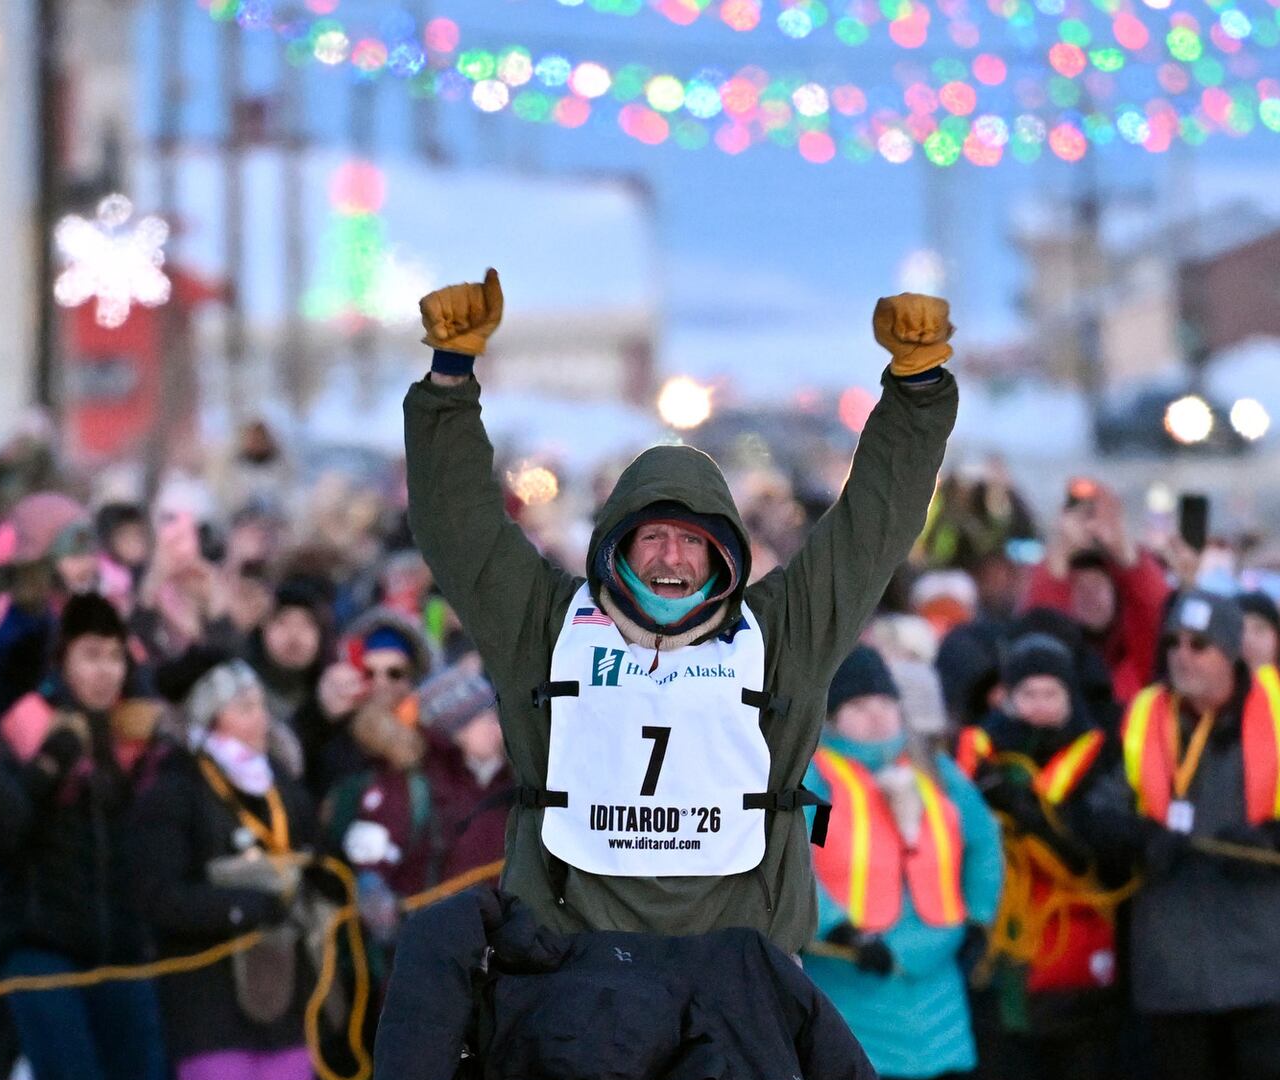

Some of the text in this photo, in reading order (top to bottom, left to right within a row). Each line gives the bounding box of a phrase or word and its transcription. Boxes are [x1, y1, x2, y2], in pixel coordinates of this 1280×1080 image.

[683, 664, 736, 678] Alaska
[640, 725, 672, 796] 7
[608, 837, 701, 850] www.iditarod.com
